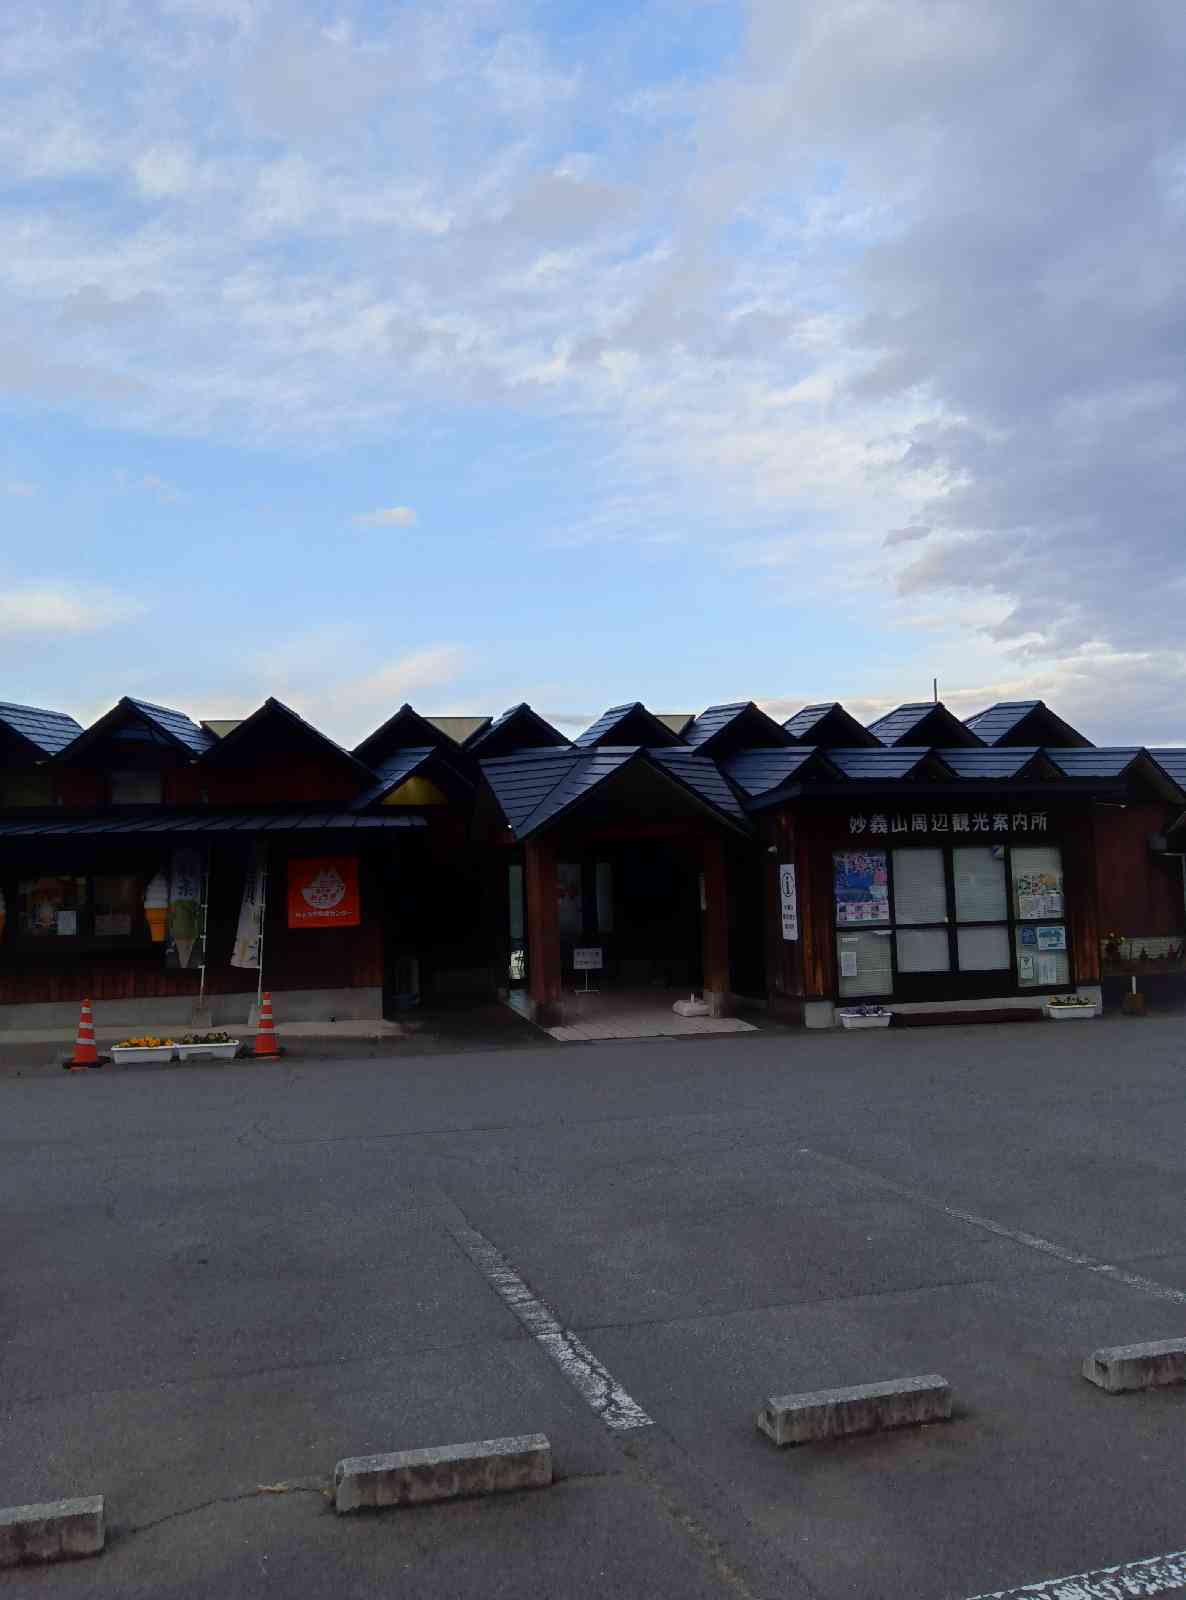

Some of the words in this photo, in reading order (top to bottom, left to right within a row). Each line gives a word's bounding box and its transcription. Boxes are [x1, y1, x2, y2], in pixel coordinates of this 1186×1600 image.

[848, 811, 1048, 834] 妙義山周辺観光案内所
